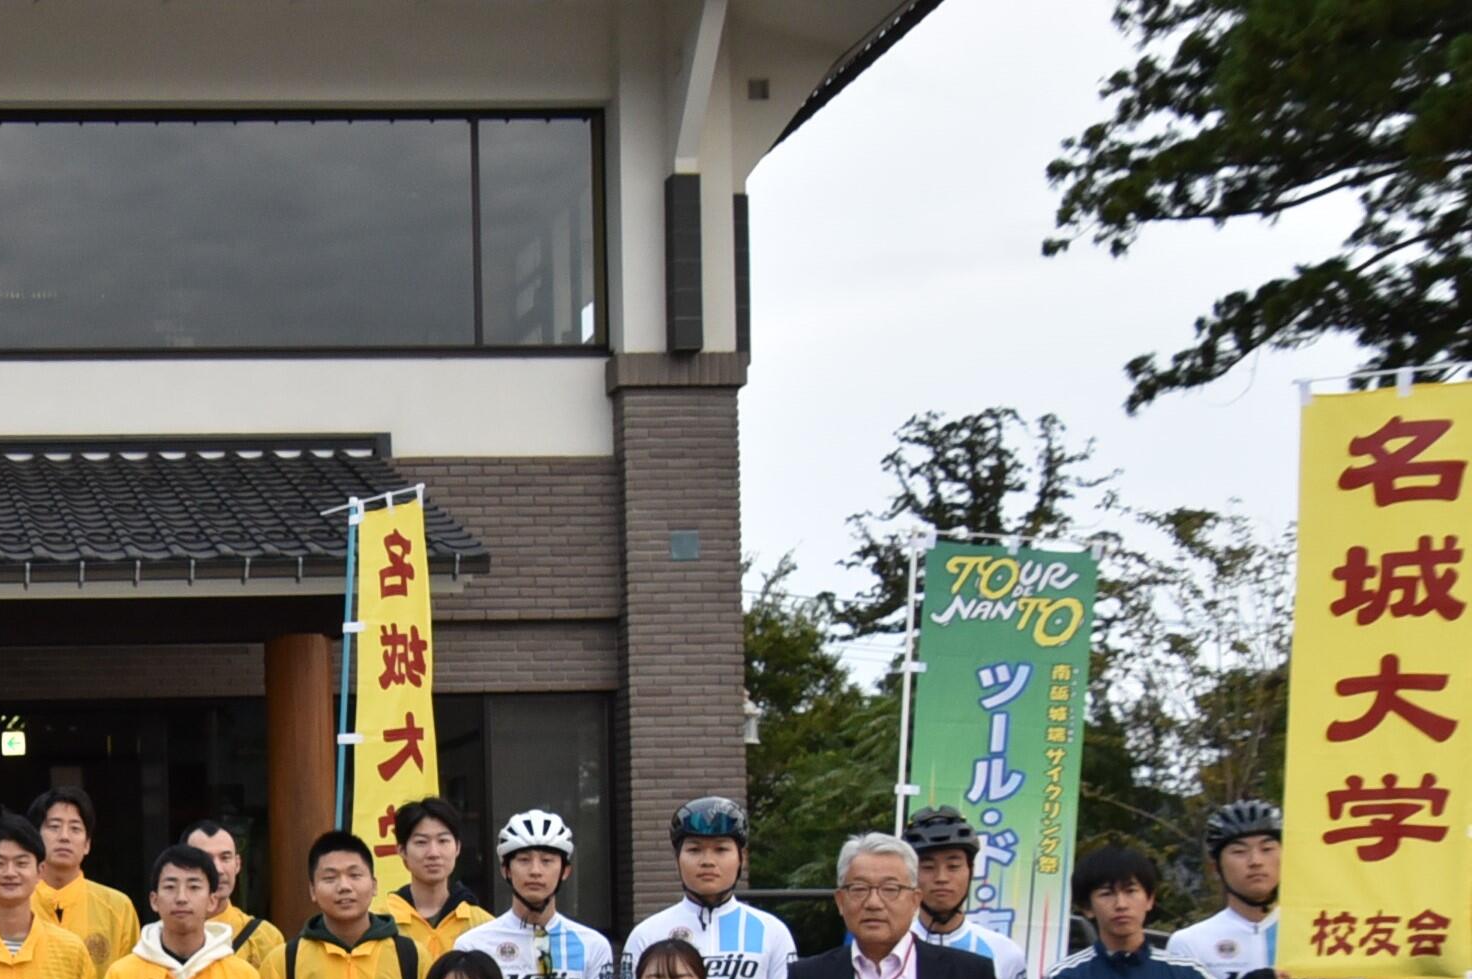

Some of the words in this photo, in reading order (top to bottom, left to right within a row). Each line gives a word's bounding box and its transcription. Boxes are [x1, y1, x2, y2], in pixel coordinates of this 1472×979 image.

[945, 556, 1079, 600] TOUR
[930, 595, 1084, 647] NANTO
[1323, 416, 1467, 862] 名城大学
[1310, 910, 1450, 956] 校友会
